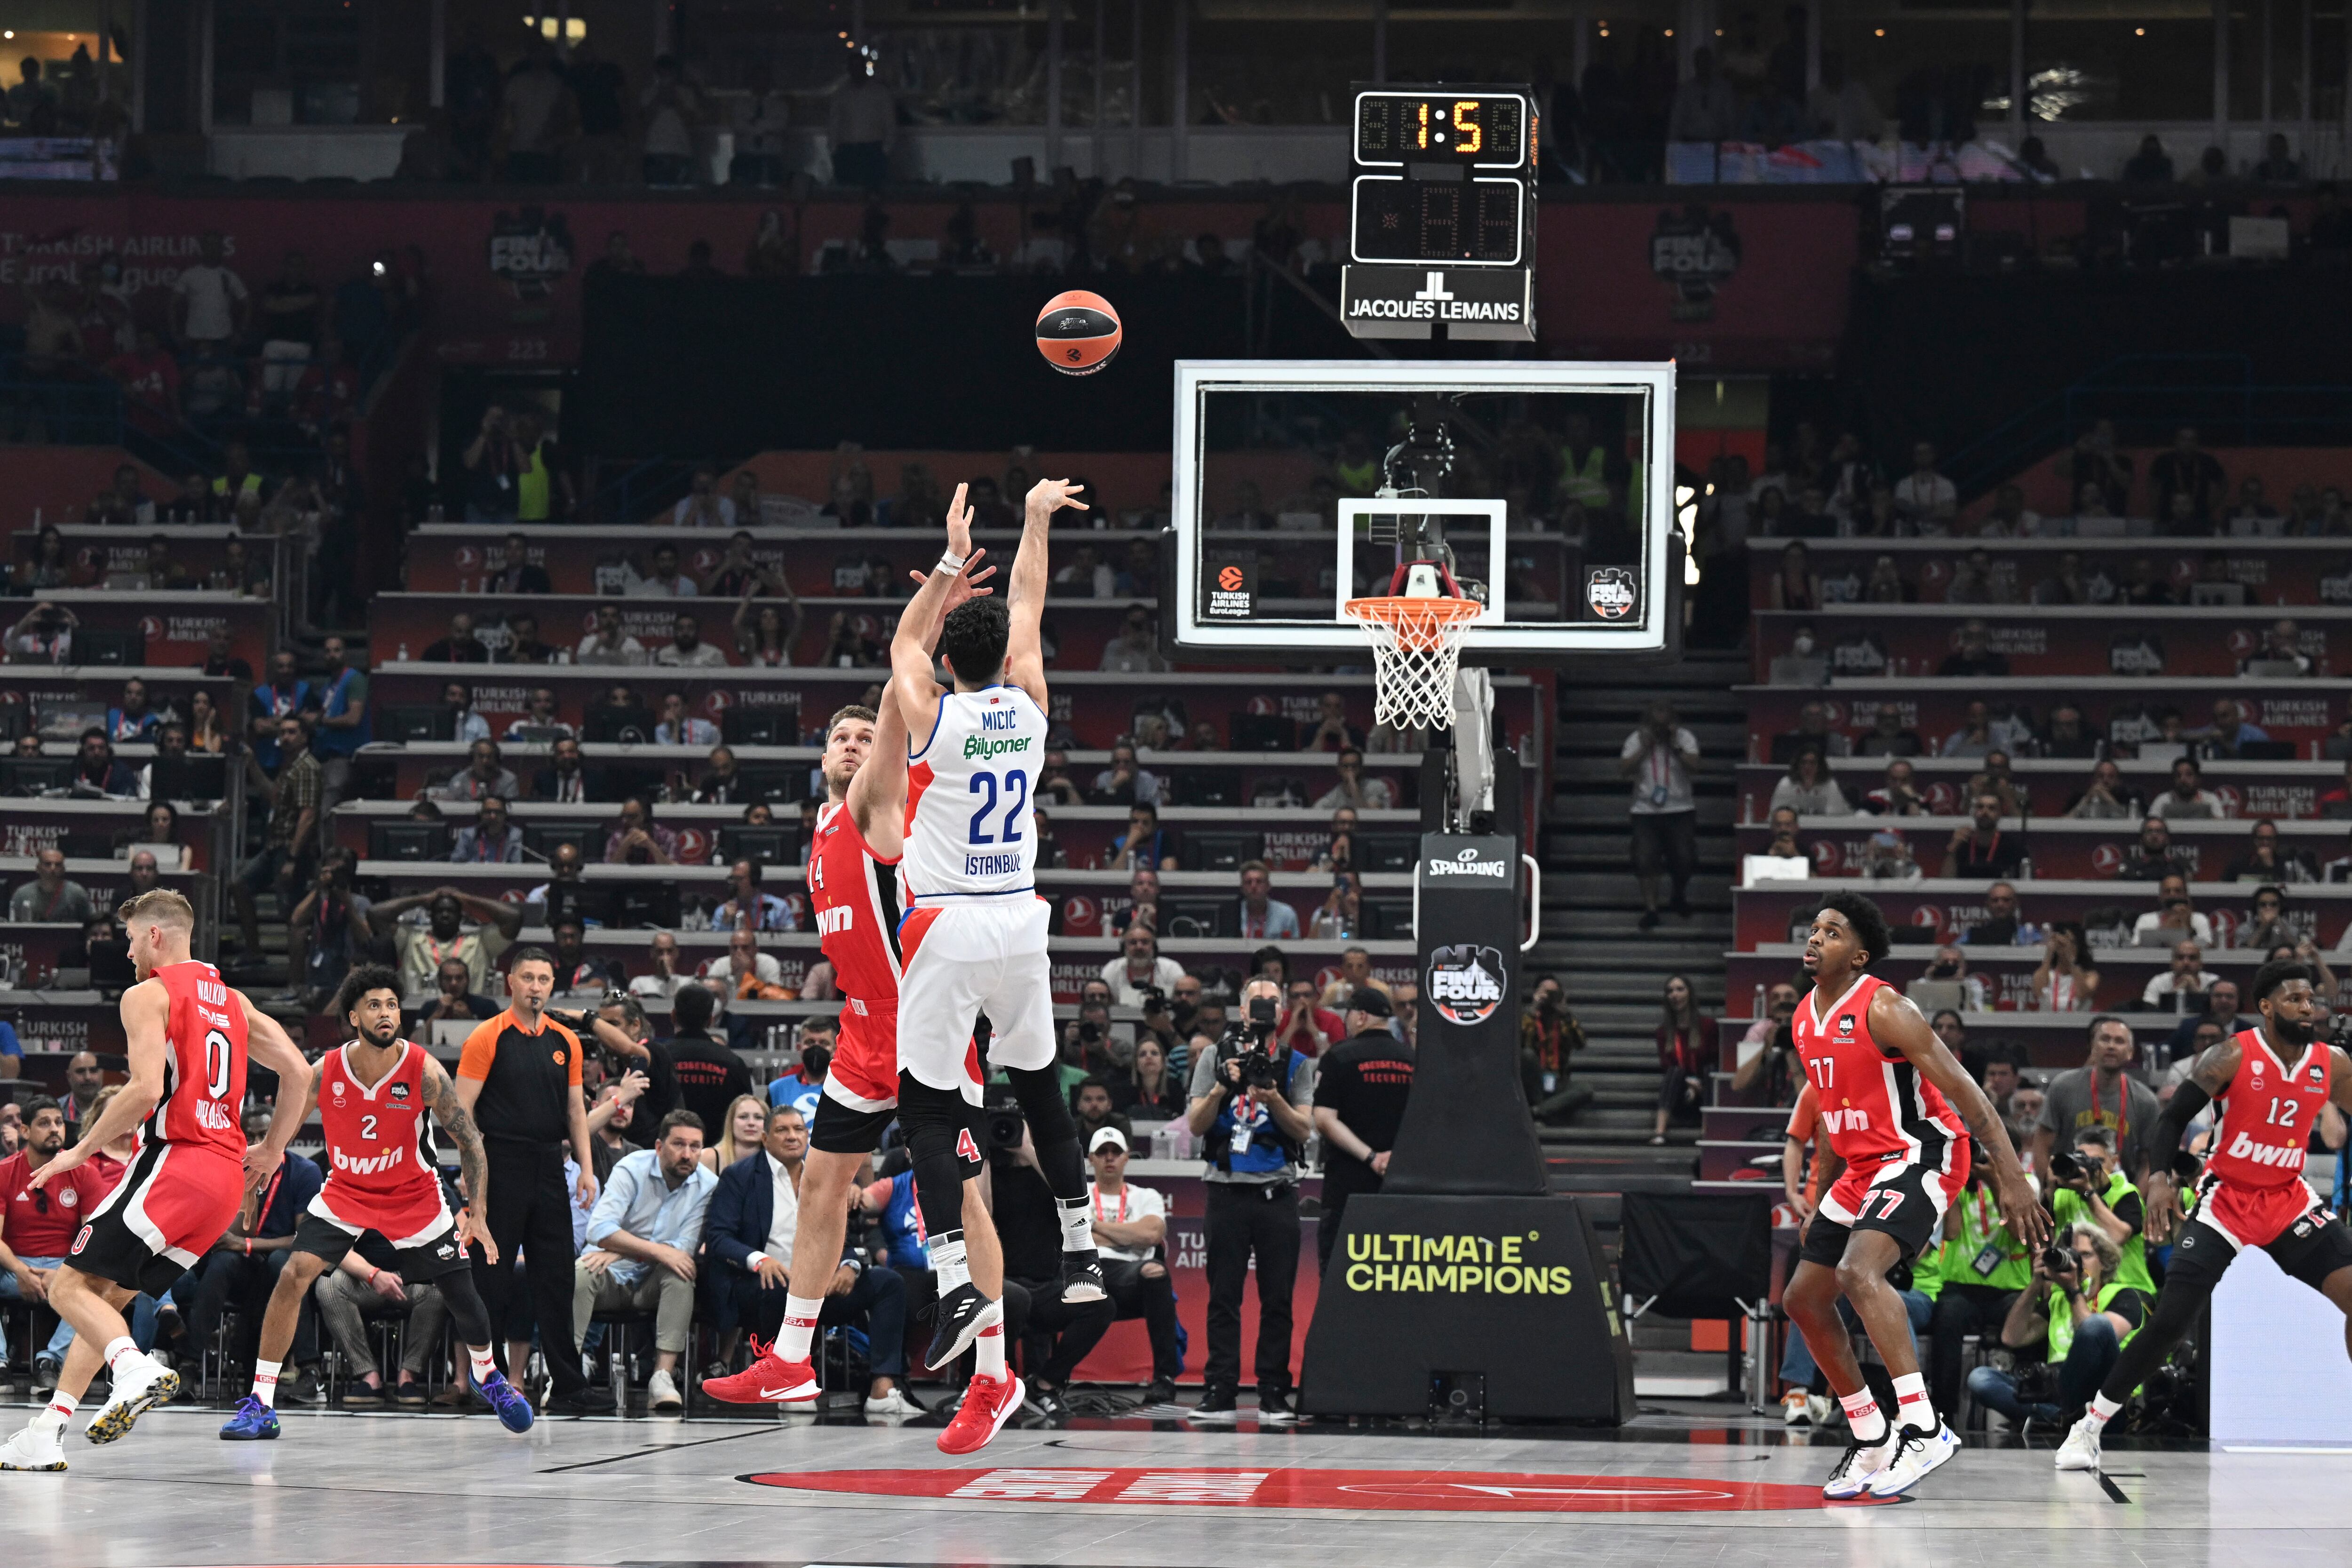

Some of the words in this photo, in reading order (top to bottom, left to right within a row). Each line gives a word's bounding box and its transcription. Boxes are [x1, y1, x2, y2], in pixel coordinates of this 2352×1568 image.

[1349, 299, 1435, 318] JACQUES
[1441, 302, 1519, 320] LEMANS
[1211, 591, 1250, 600] TURKISH
[1590, 593, 1632, 603] FOUR
[1209, 607, 1250, 616] EuroLeague
[982, 706, 1016, 731] MICIĆ
[963, 734, 1032, 760] Bilyoner
[2247, 785, 2315, 799] TURKISH
[969, 769, 1027, 844] 22
[809, 854, 824, 893] 14
[1430, 860, 1505, 878] SPALDING
[815, 896, 853, 938] win
[1433, 964, 1494, 986] FINAL
[196, 979, 227, 1007] WALKUP
[1433, 986, 1500, 1000] FOUR
[27, 1021, 88, 1035] URKISH
[205, 1028, 232, 1101] 0
[1809, 1056, 1834, 1089] 77
[1822, 1098, 1869, 1134] win
[2266, 1097, 2299, 1128] 12
[361, 1114, 377, 1140] 2
[333, 1146, 403, 1175] bwin
[2227, 1132, 2304, 1169] bwin
[1856, 1188, 1905, 1221] 77
[1347, 1234, 1523, 1264] ULTIMATE
[1346, 1263, 1573, 1295] CHAMPIONS
[259, 1375, 275, 1384] GSA
[1853, 1403, 1877, 1417] GSA
[946, 1469, 1115, 1499] AIRLINES
[1113, 1472, 1269, 1502] TURKISH
